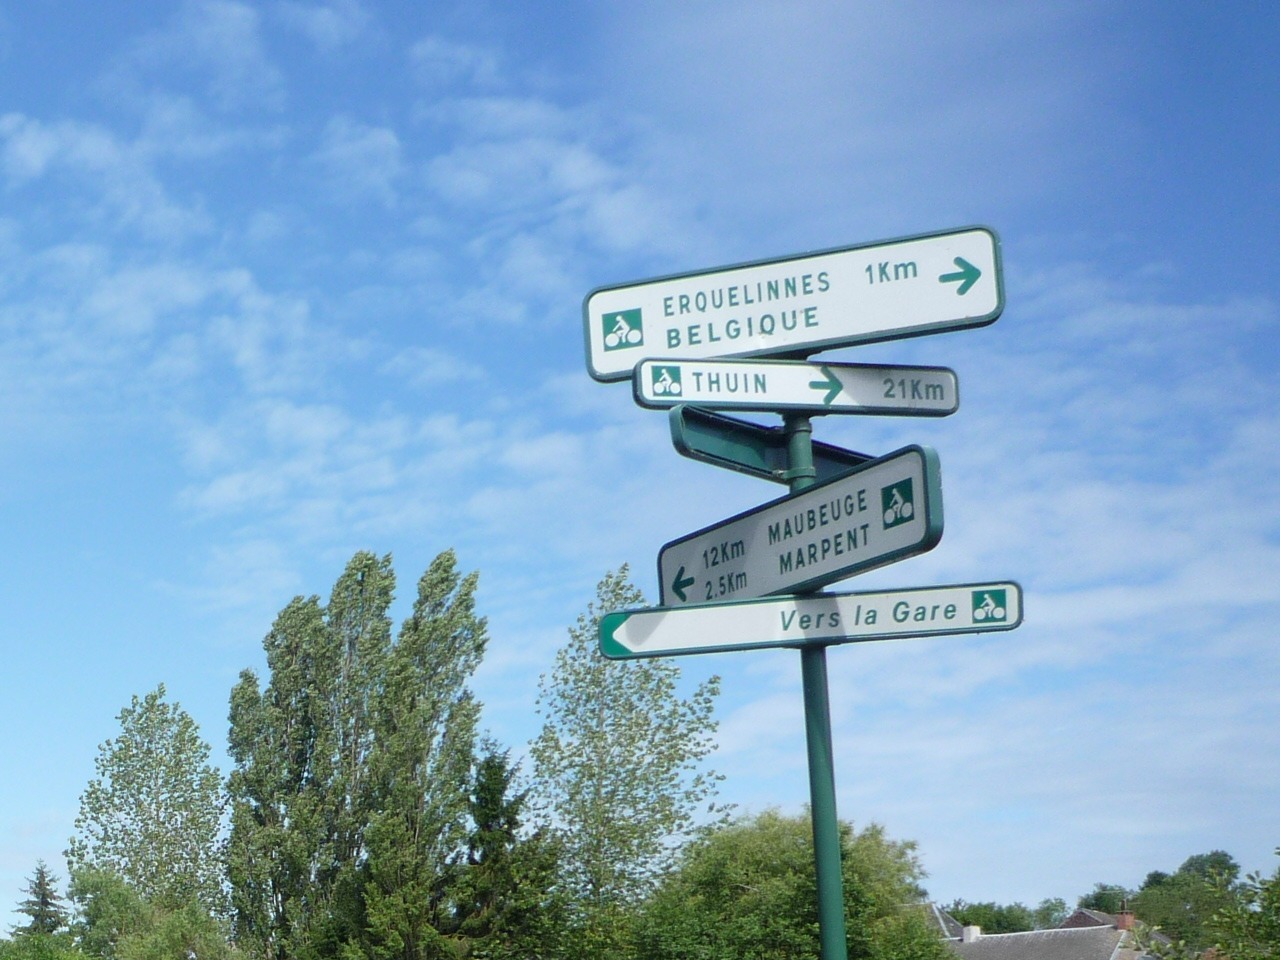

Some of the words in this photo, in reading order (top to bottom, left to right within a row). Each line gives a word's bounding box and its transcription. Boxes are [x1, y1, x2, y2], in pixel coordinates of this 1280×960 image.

[663, 272, 831, 317] ERQUELINNES
[865, 260, 918, 285] 1Km
[667, 306, 820, 349] BELGIQUE
[691, 372, 768, 394] THUIN
[883, 378, 945, 400] 21Km
[703, 539, 745, 570] 12Km
[768, 489, 868, 546] MAUBEUGE
[779, 524, 870, 575] MARPENT
[780, 608, 840, 632] Vers
[854, 605, 877, 627] la
[893, 601, 957, 623] Gare
